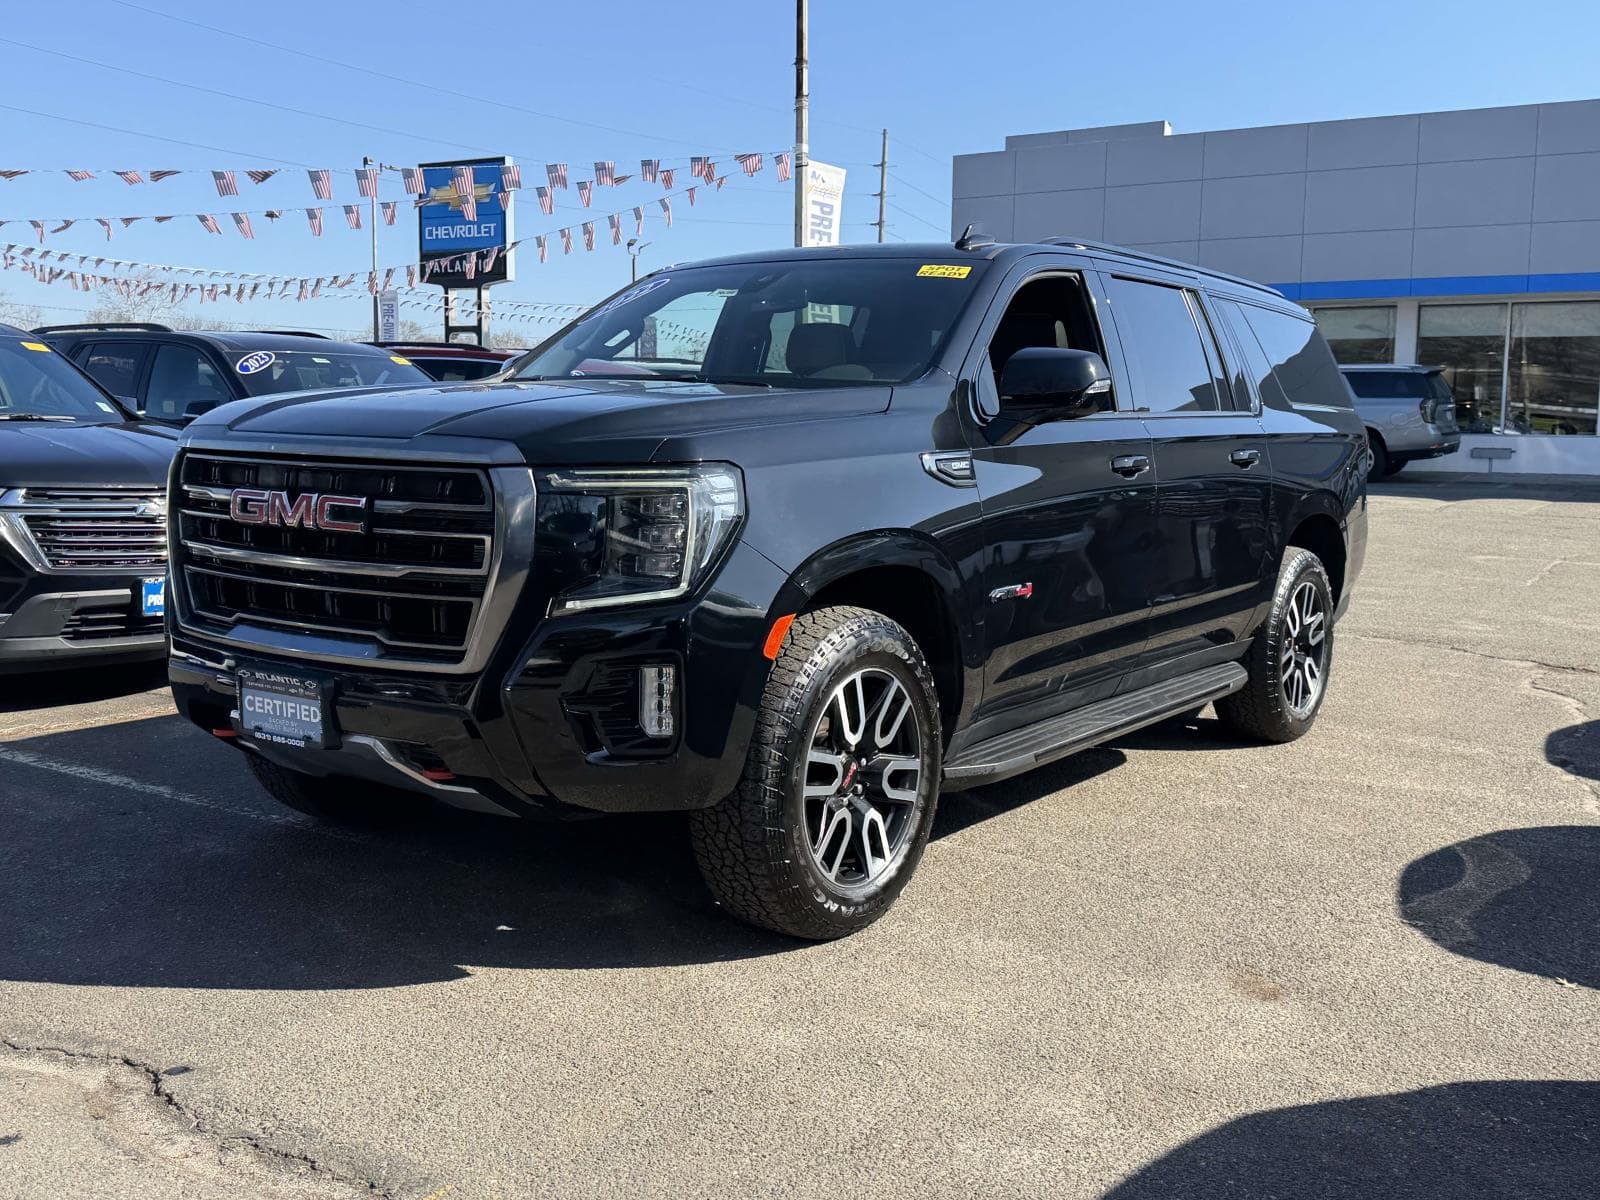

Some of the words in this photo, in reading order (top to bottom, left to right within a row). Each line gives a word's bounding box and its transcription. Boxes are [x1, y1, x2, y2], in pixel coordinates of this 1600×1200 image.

[425, 223, 497, 240] CHEVROLET
[433, 258, 490, 273] ATLANIC
[242, 352, 270, 371] 2023
[230, 488, 366, 534] GMC
[254, 671, 301, 686] ATLANTIC
[244, 694, 322, 723] CERTIFIED
